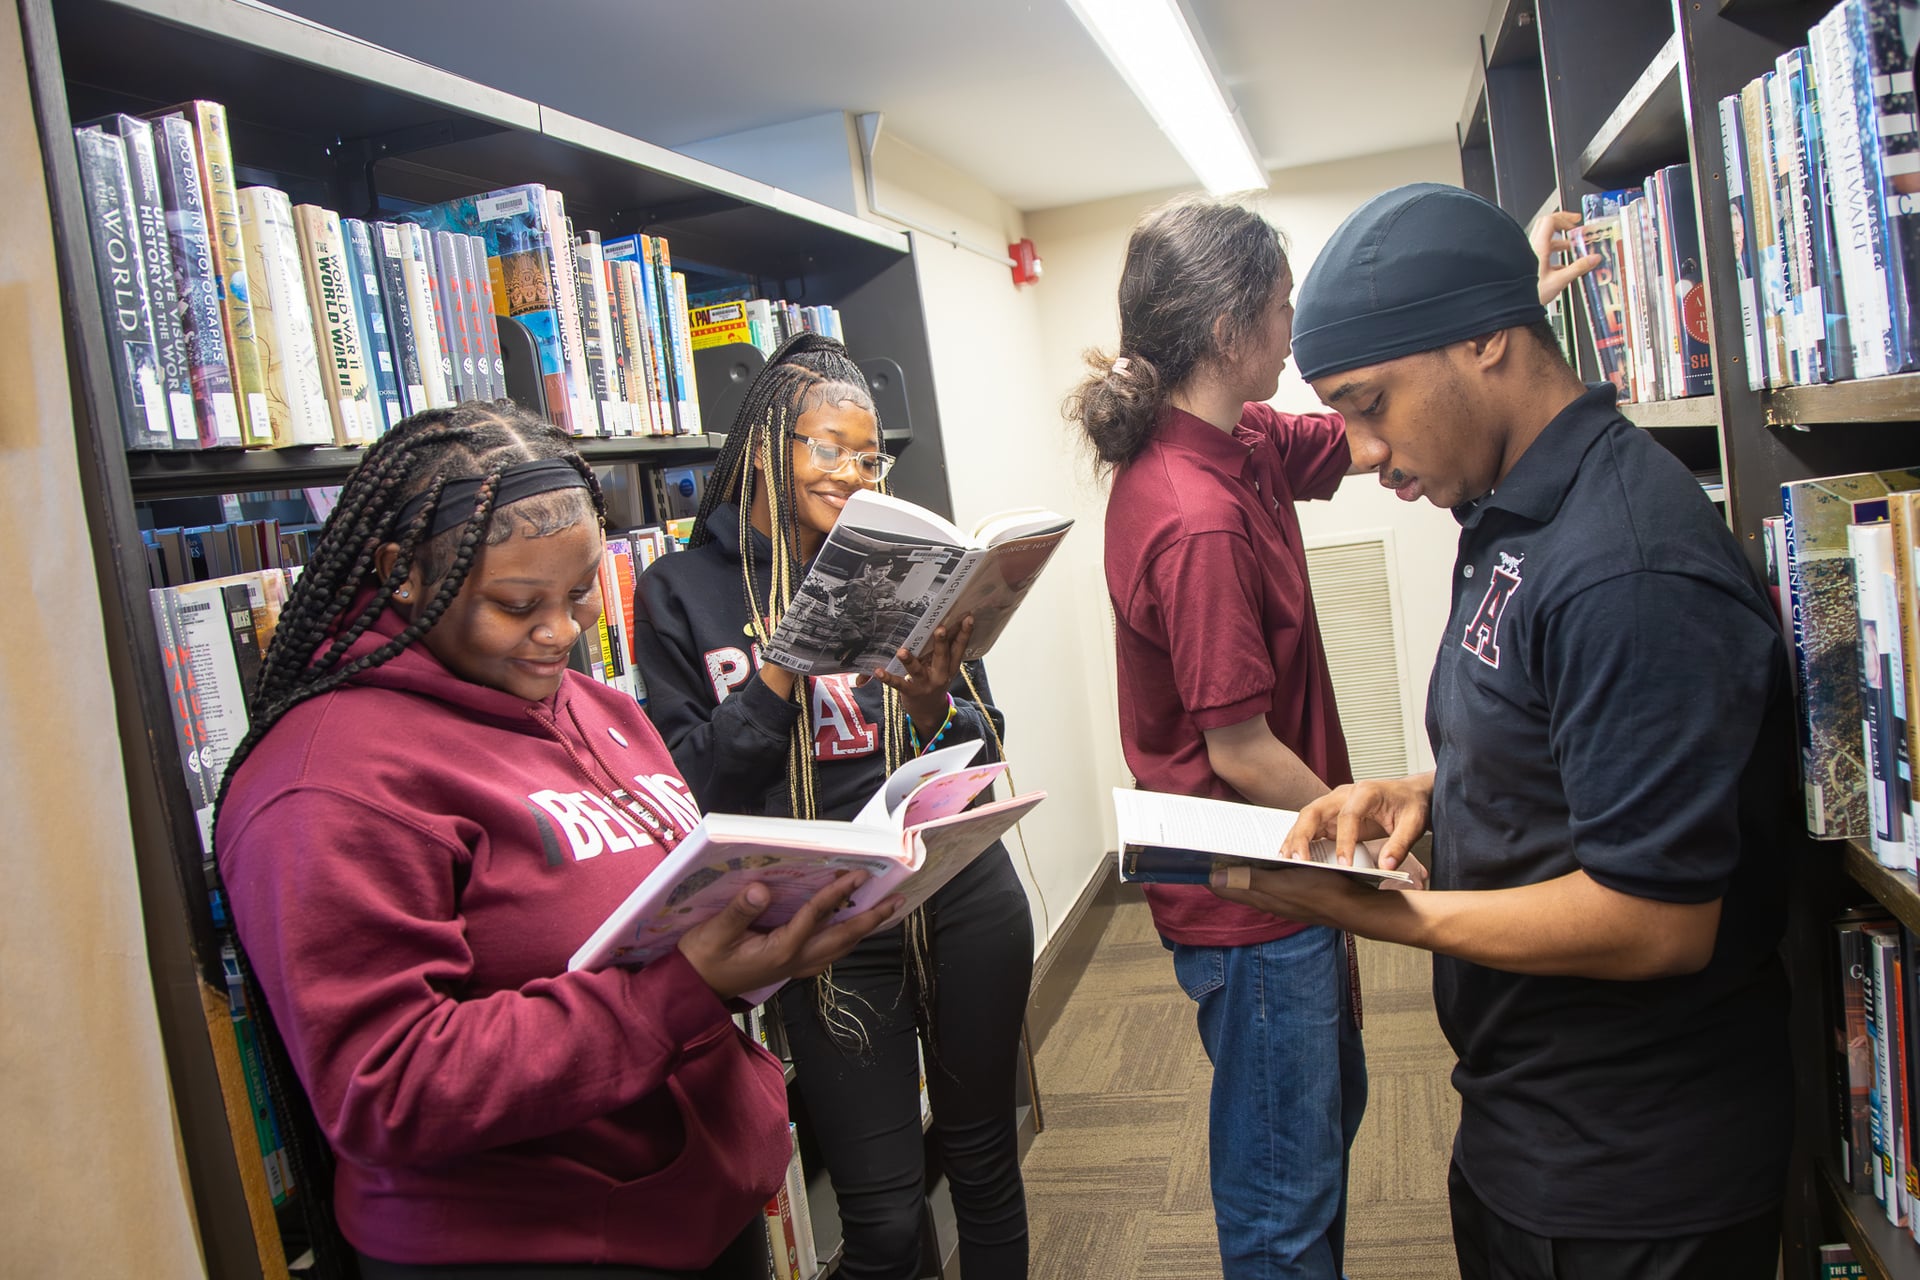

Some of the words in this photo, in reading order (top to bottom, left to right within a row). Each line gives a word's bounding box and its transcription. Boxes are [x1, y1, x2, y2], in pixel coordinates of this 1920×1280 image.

[181, 165, 199, 207] DAYS
[189, 209, 202, 227] IN
[137, 202, 164, 288] HISTORY
[101, 207, 139, 334] WORLD
[150, 203, 179, 303] ULTIMATE
[167, 306, 190, 377] VISUAL
[317, 257, 340, 324] WORLD
[549, 259, 560, 290] THE
[152, 288, 165, 310] OF
[192, 231, 225, 363] PHOTOGRAPHS
[329, 253, 348, 315] WORLD
[340, 318, 356, 357] WAR
[348, 358, 358, 370] II
[390, 262, 414, 352] FLYBOYS
[666, 296, 679, 343] NATIONAL
[155, 311, 170, 340] THE
[329, 328, 348, 370] WAR
[553, 292, 571, 362] AMERICAS
[338, 372, 351, 388] II
[672, 344, 683, 377] PARKS
[949, 558, 977, 594] PRINCE
[1783, 510, 1798, 596] ANCIENT
[924, 597, 947, 630] HARRY
[1461, 565, 1522, 669] A
[1790, 602, 1803, 651] CITY
[1873, 968, 1883, 1006] THE
[1874, 1012, 1889, 1087] TRUTHS
[242, 1047, 267, 1106] IRELAND
[1880, 1093, 1889, 1123] WE
[1830, 1265, 1848, 1276] THE
